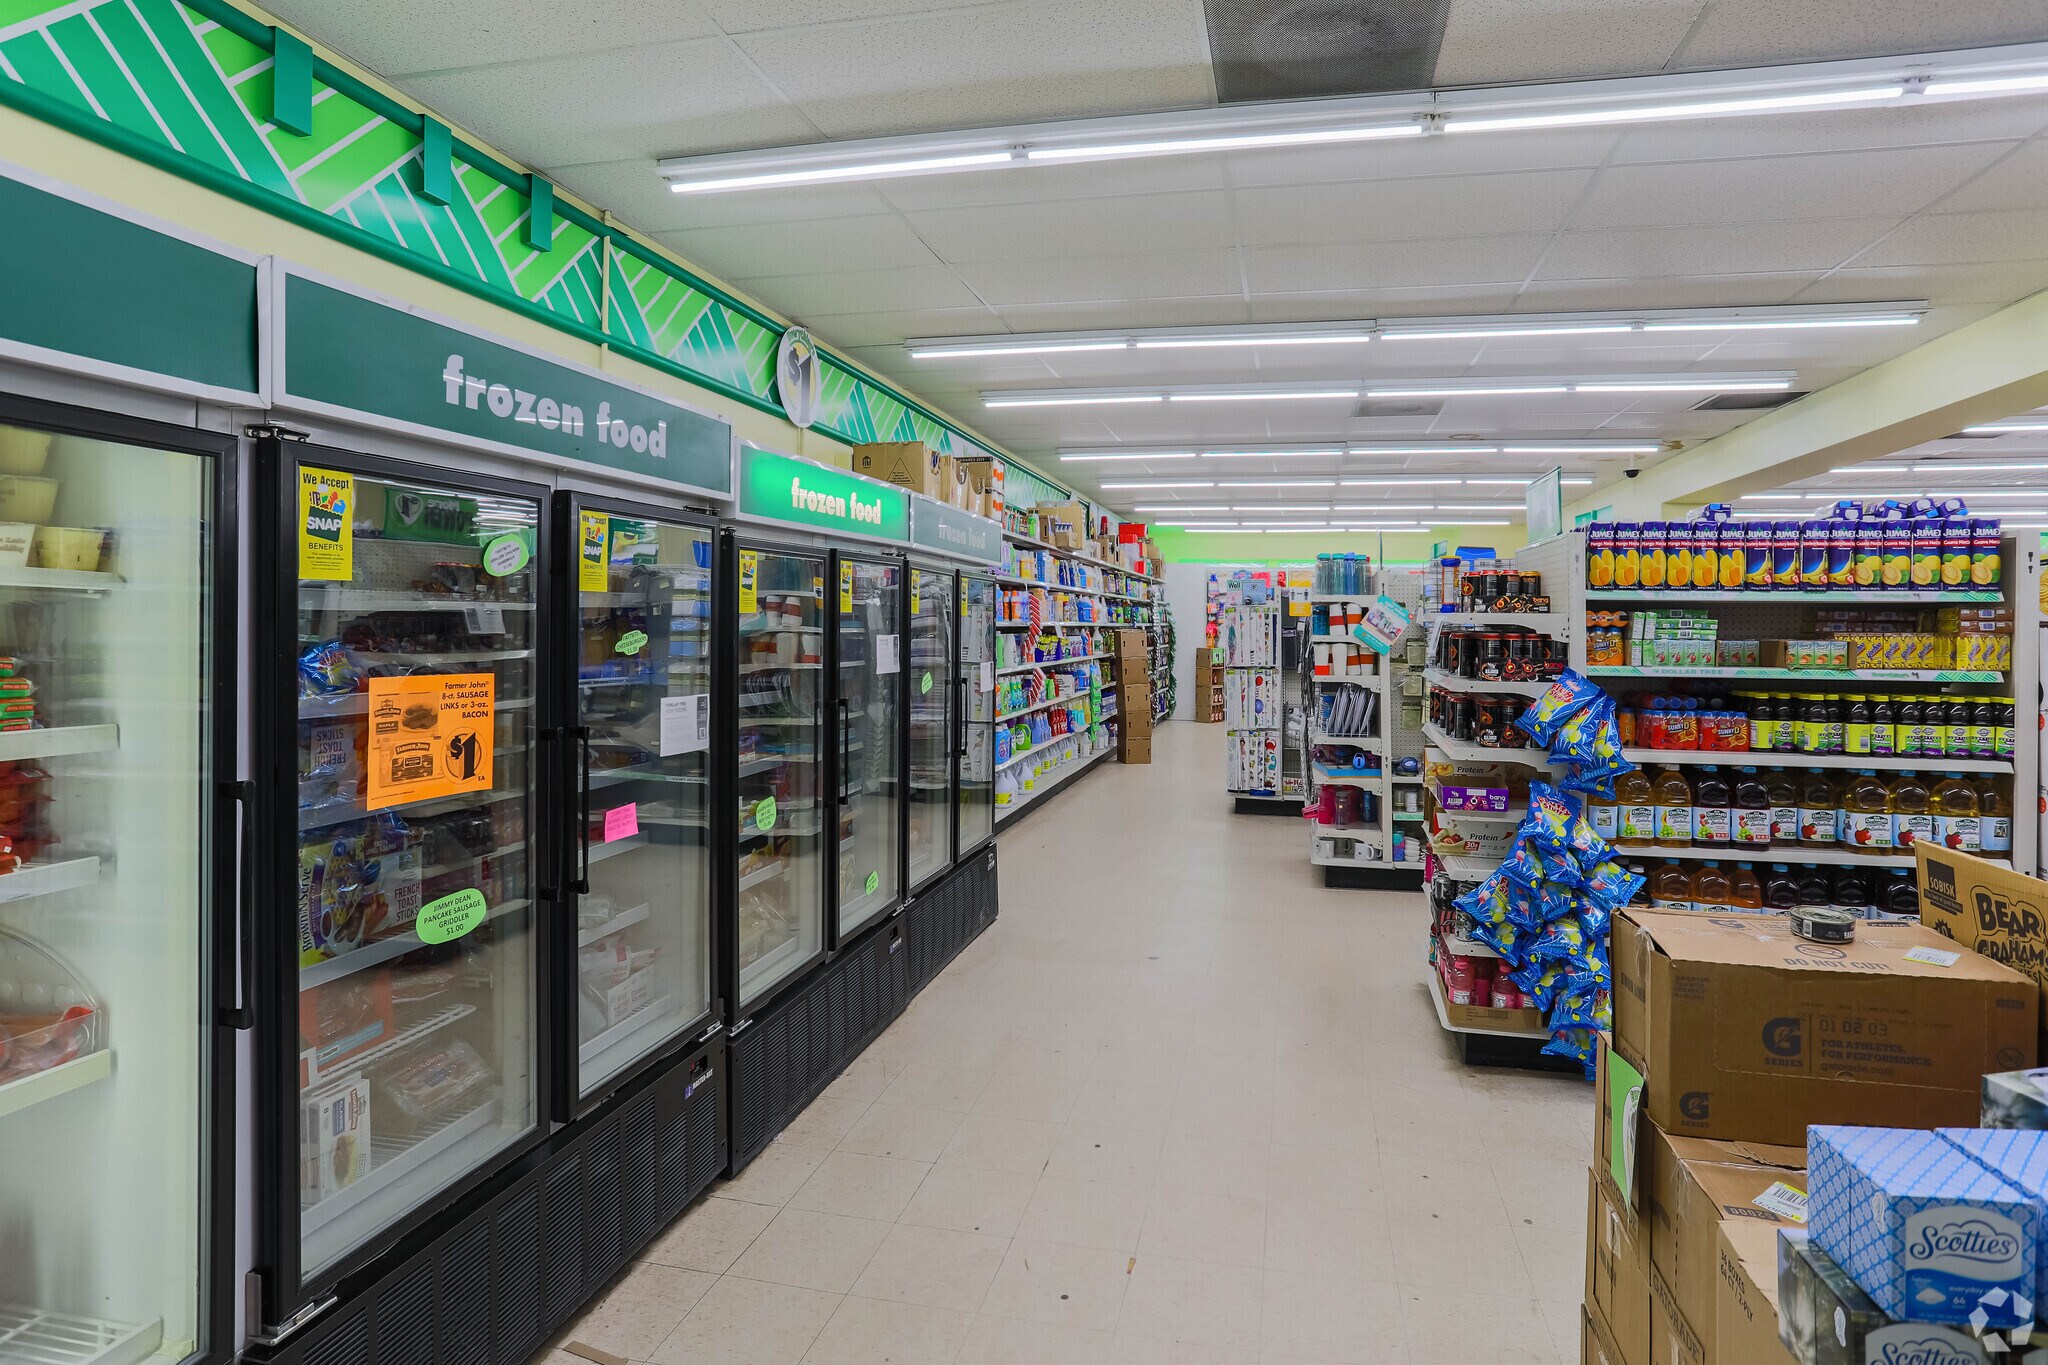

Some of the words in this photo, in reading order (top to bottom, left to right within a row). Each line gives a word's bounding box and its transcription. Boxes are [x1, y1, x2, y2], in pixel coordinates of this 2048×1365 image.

[443, 354, 584, 437] frozen
[596, 401, 667, 459] food
[303, 473, 317, 485] We
[320, 475, 350, 490] Accept
[791, 477, 846, 518] frozen
[850, 492, 881, 525] food
[307, 516, 342, 531] SNAP
[582, 514, 590, 523] We
[938, 517, 967, 546] frozen
[968, 527, 986, 550] food
[1590, 530, 1614, 538] JUMEX
[1616, 530, 1640, 538] JUMEX
[1642, 530, 1666, 538] JUMEX
[1668, 530, 1692, 538] JUMEX
[1693, 530, 1718, 538] JUMEX
[1720, 530, 1745, 538] JUMEX
[1746, 530, 1772, 538] JUMEX
[1773, 530, 1799, 538] JUMEX
[1804, 530, 1829, 538] JUMEX
[1830, 530, 1855, 538] JUMEX
[1856, 530, 1882, 538] JUMEX
[1884, 530, 1911, 538] JUMEX
[1914, 529, 1941, 537] JUMEX
[1973, 528, 2000, 536] JUMEX
[308, 542, 344, 551] BENEFITS
[584, 545, 603, 556] SNAP
[1533, 596, 1549, 604] bang
[444, 682, 468, 690] Farmer
[441, 692, 455, 700] 8-ct.
[456, 690, 489, 699] SAUSAGE
[440, 702, 460, 710] LINKS
[470, 701, 489, 709] 3-oz.
[461, 711, 489, 719] BACON
[316, 728, 344, 742] STICKS
[318, 741, 344, 755] TOAST
[450, 731, 477, 781] $1
[1457, 765, 1484, 774] Protein
[1489, 794, 1506, 802] bang
[1470, 832, 1499, 841] Protein
[394, 882, 420, 900] FRENCH
[1929, 876, 1956, 898] SOBISK
[397, 894, 419, 910] TOAST
[433, 899, 454, 913] JIMMY
[454, 893, 472, 905] DEAN
[396, 905, 420, 922] STICKS
[423, 908, 453, 925] PANCAKE
[453, 899, 482, 915] SAUSAGE
[1975, 892, 2041, 939] BEAR
[438, 912, 470, 929] GRIDDLER
[446, 923, 464, 936] $1.00
[1977, 939, 2048, 972] GRAHAM
[1784, 957, 1810, 966] DO
[1813, 959, 1845, 968] NOT
[1850, 961, 1893, 971] CUT!
[1819, 1018, 1837, 1033] 01
[1842, 1020, 1862, 1034] 02
[1868, 1022, 1888, 1036] 03
[1821, 1039, 1844, 1049] FOR
[1845, 1040, 1907, 1053] ATHLETES.
[1764, 1057, 1804, 1069] SERIES
[1821, 1050, 1844, 1060] FOR
[1846, 1052, 1934, 1067] PERFORMANCE.
[1820, 1062, 1895, 1076] gatorade.com
[1680, 1119, 1710, 1129] SERIES
[1603, 1167, 1638, 1233] GATORDE
[1909, 1225, 2011, 1261] Scotties
[1727, 1260, 1746, 1295] BOXES
[1948, 1286, 1984, 1295] everyday
[1727, 1275, 1735, 1292] CT
[1738, 1292, 1754, 1322] 2-PLY
[1952, 1295, 1966, 1305] 64
[1651, 1273, 1700, 1363] GATORADE
